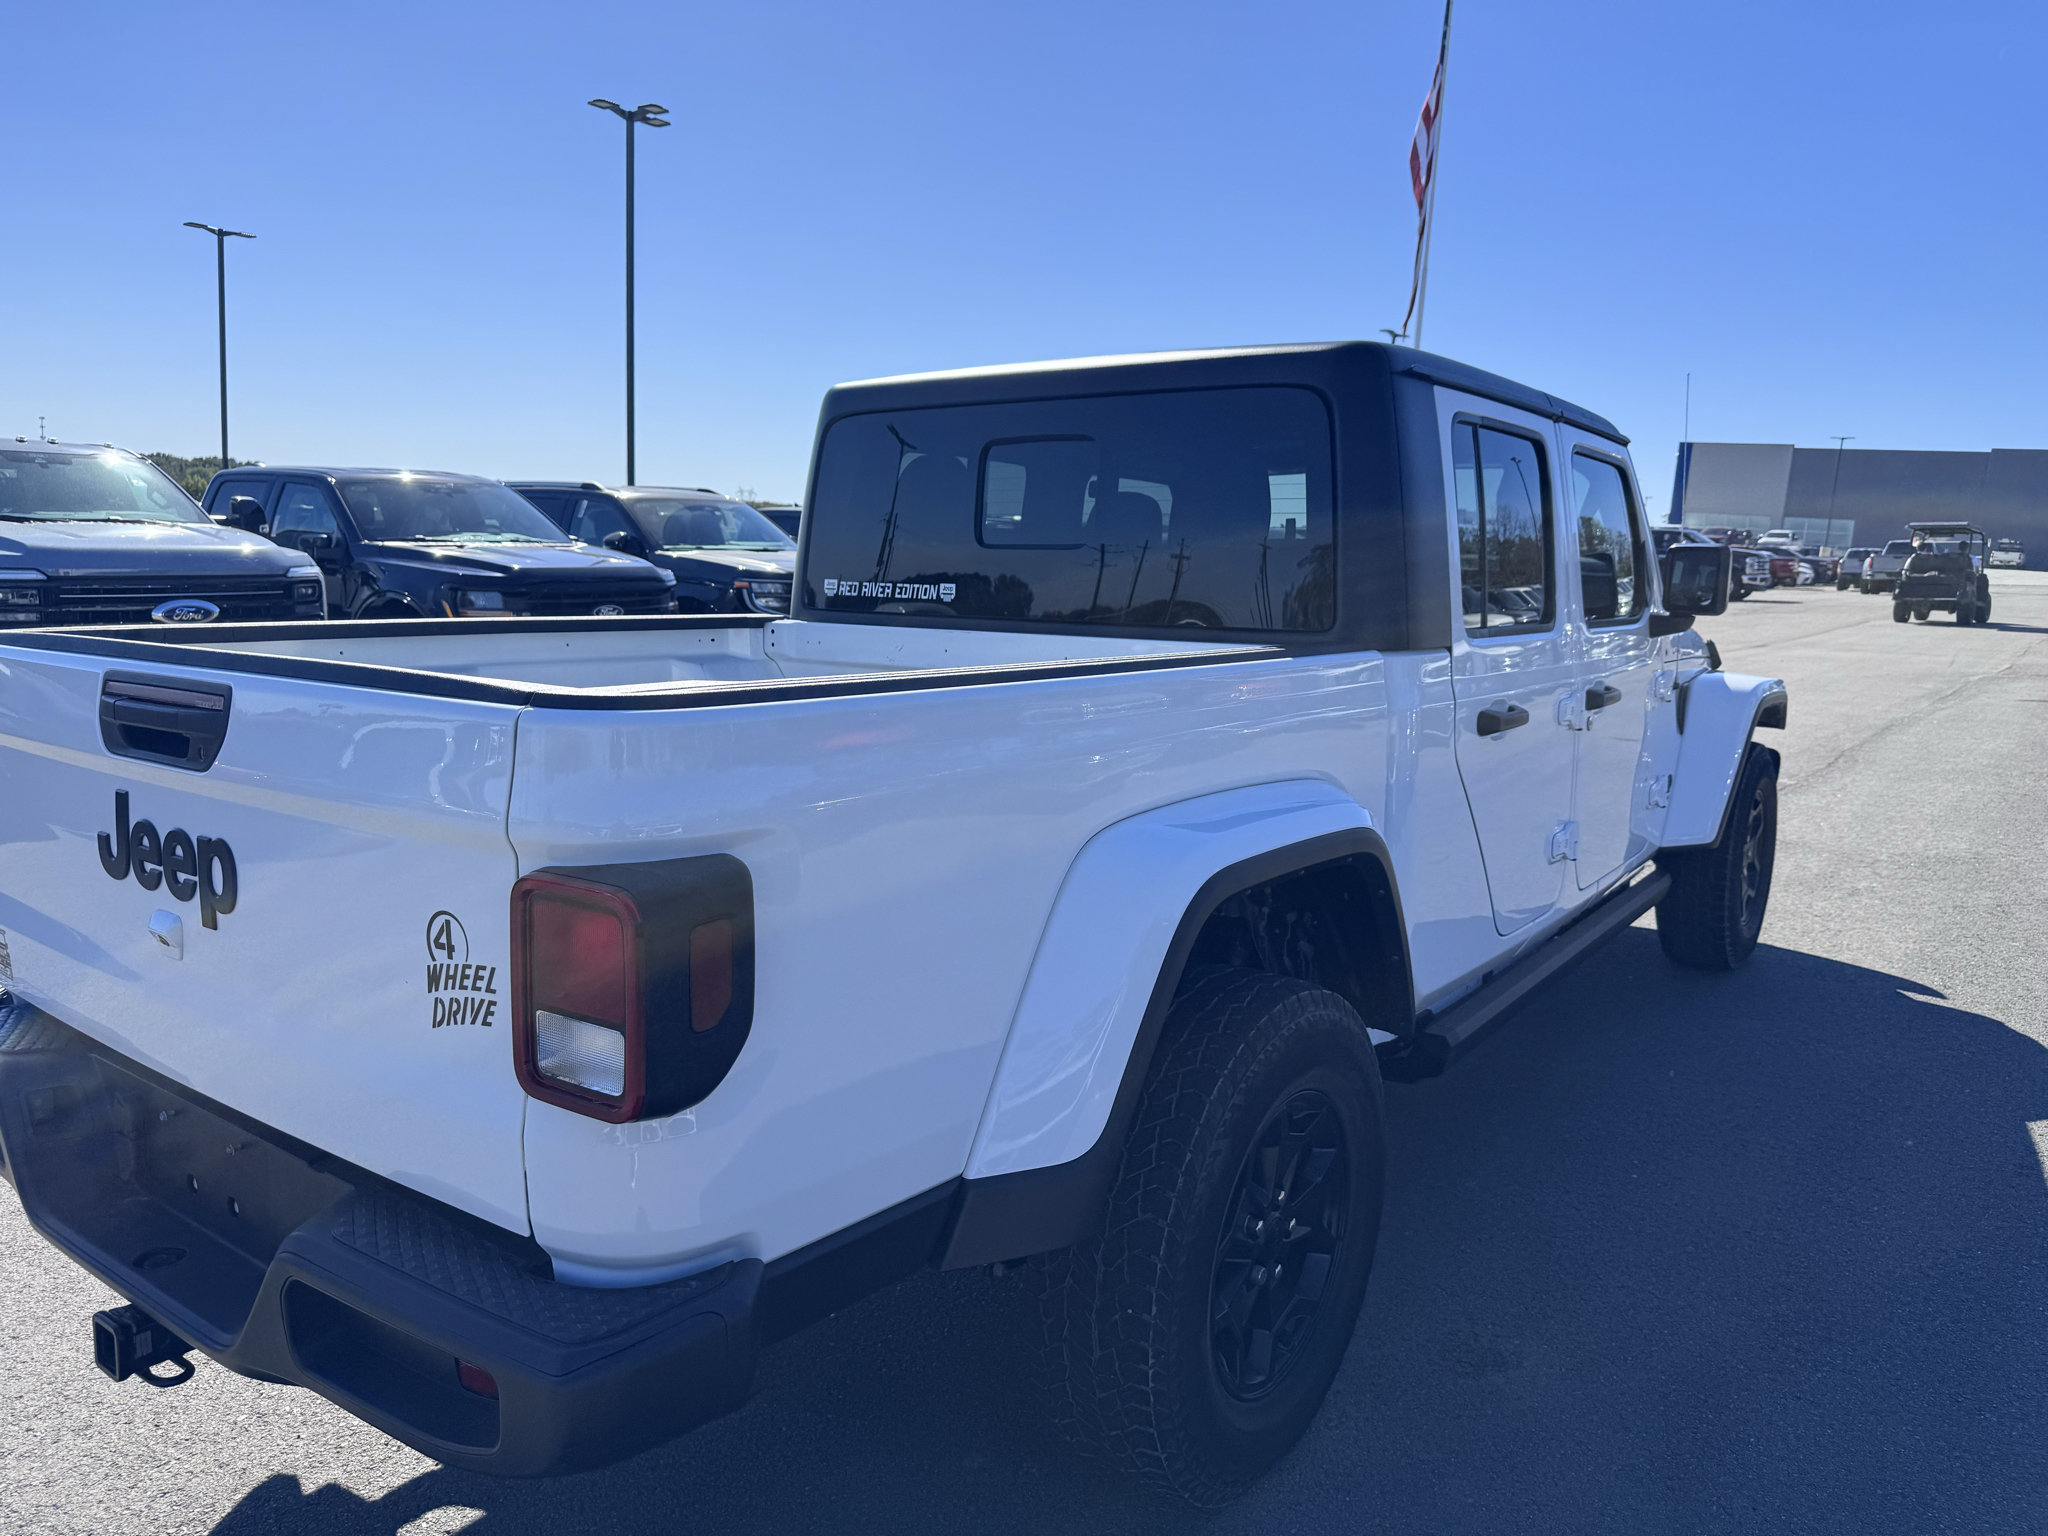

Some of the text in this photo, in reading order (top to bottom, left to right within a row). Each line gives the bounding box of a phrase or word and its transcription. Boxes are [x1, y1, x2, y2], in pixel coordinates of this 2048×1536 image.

[838, 581, 859, 596] RED
[861, 582, 892, 597] RIVER
[895, 583, 939, 600] EDITION
[173, 607, 205, 621] Ford
[97, 788, 238, 931] Jeep
[432, 918, 456, 961] 4
[426, 963, 497, 995] WHEEL
[432, 996, 498, 1029] DRIVE
